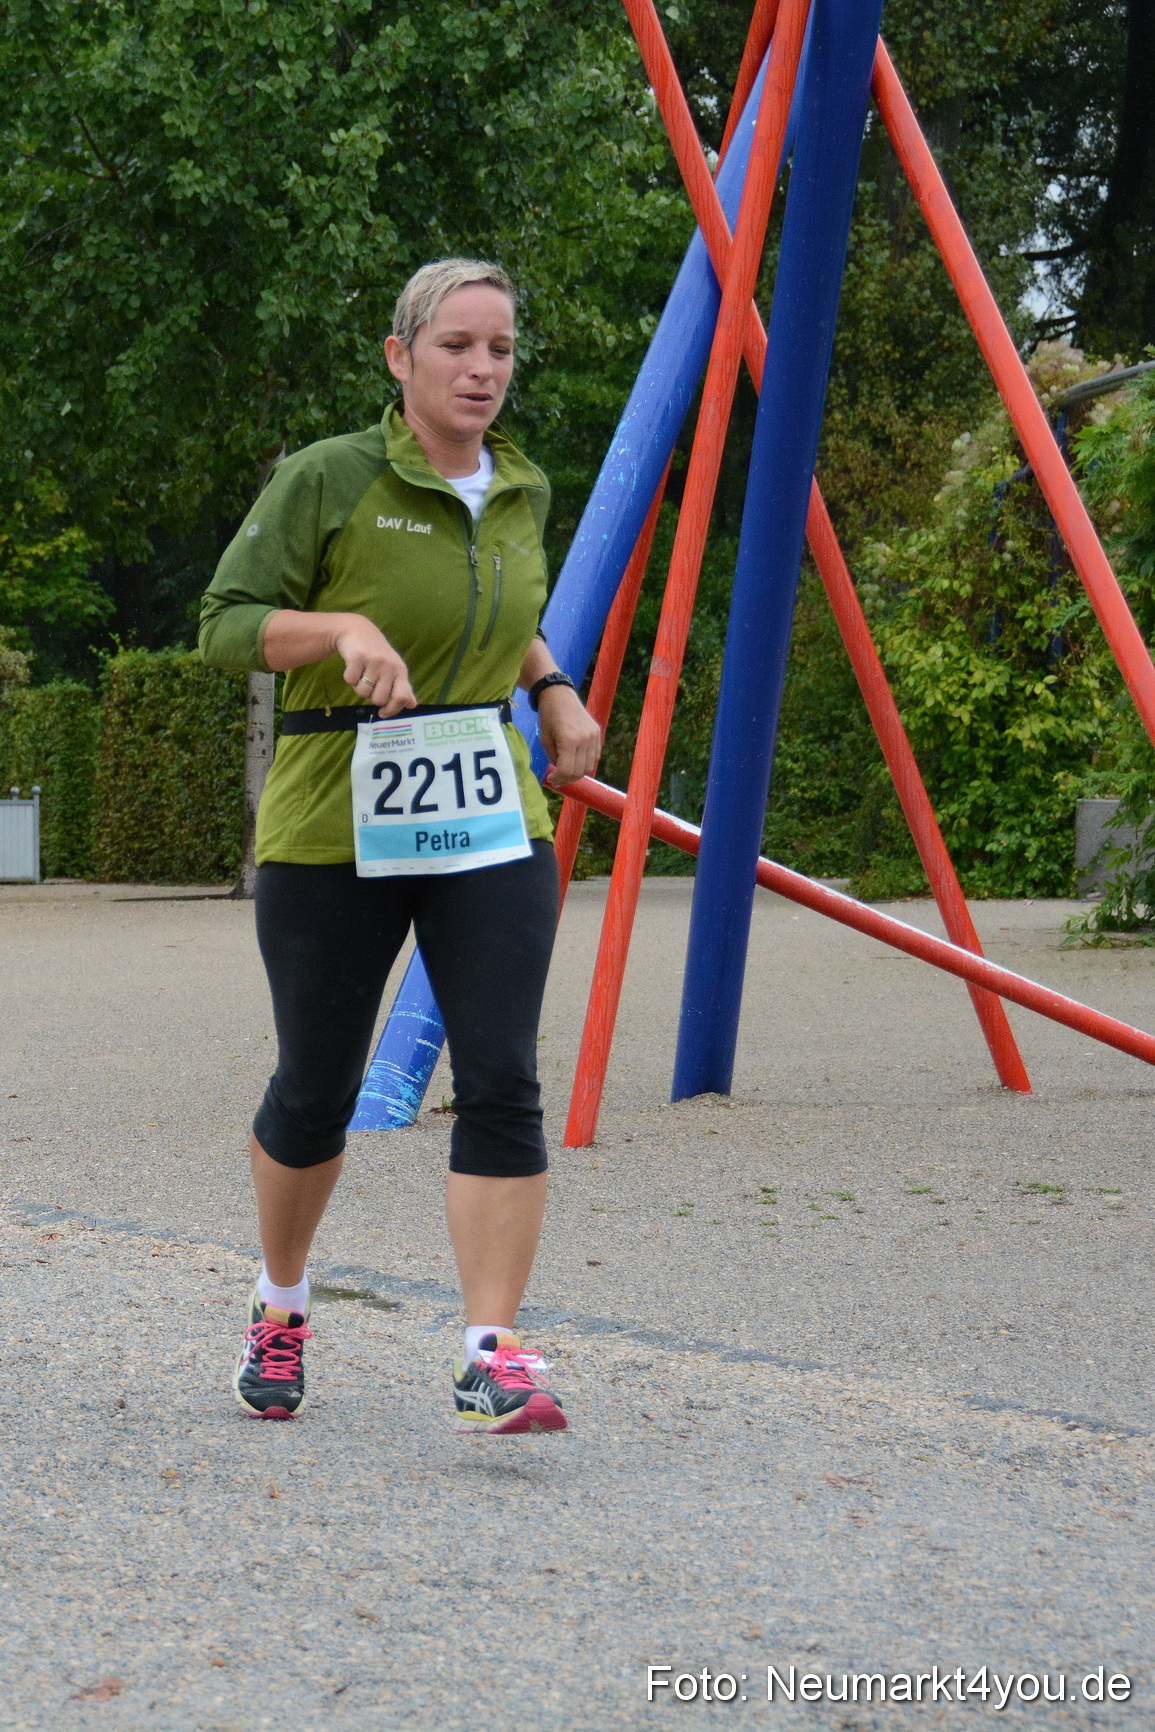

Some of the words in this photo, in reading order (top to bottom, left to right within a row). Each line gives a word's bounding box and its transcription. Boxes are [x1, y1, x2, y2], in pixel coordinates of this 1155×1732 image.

[376, 515, 402, 529] DAV
[406, 519, 432, 535] Lauf
[423, 716, 492, 740] BOCK
[372, 749, 502, 815] 2215
[415, 830, 471, 852] Petra
